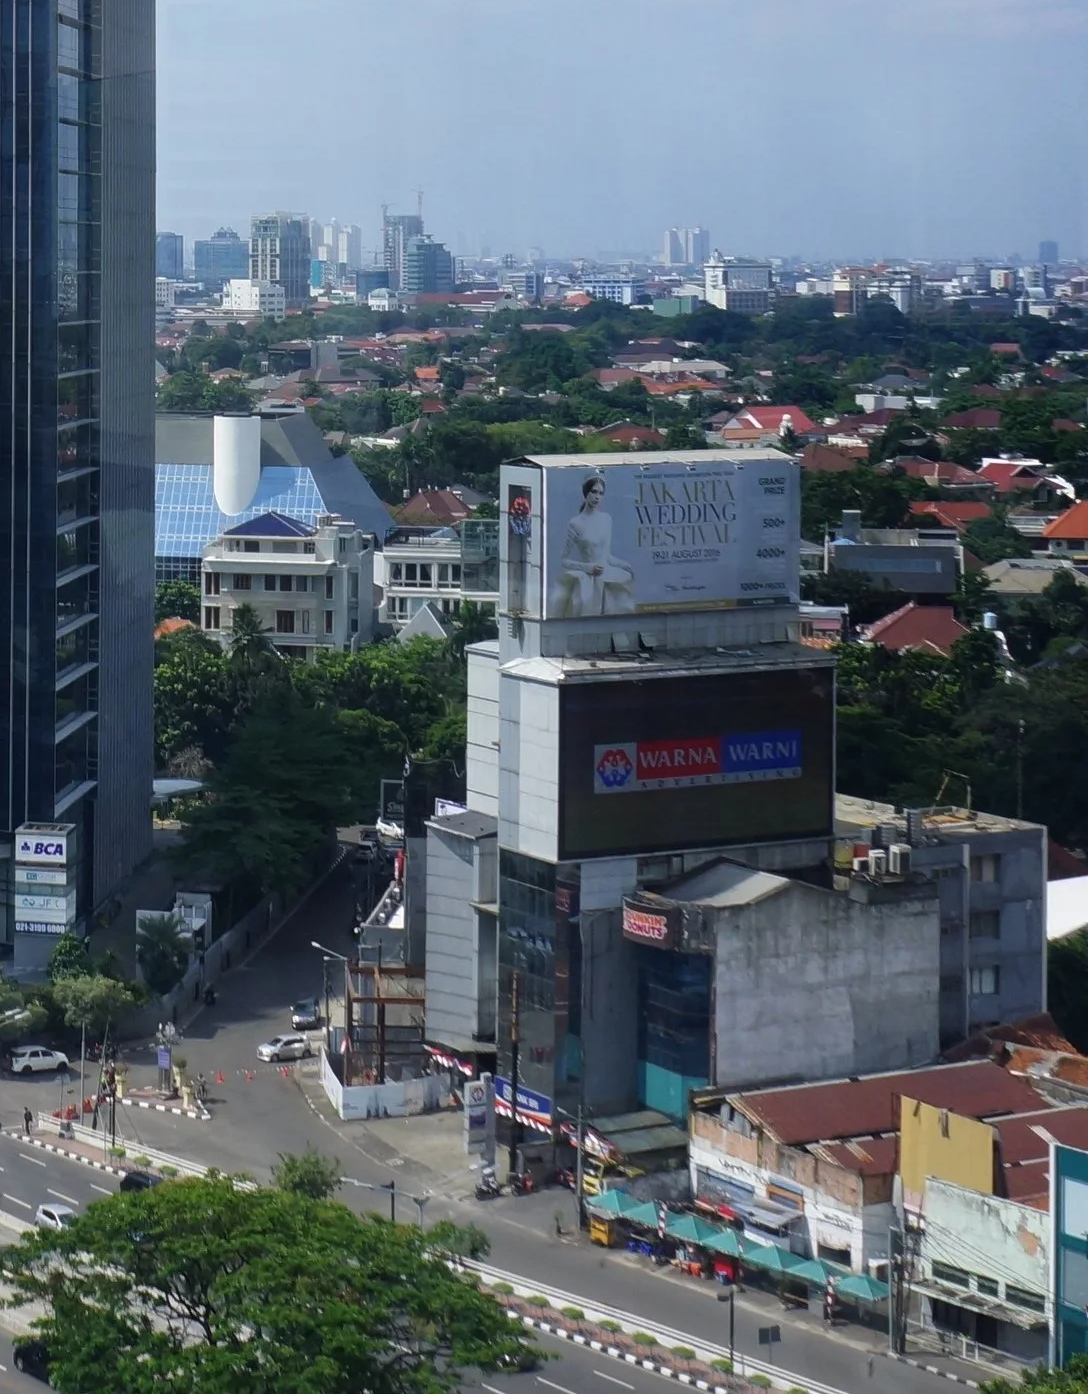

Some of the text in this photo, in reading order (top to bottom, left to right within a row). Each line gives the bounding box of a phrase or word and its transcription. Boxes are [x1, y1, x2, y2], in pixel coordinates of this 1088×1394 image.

[758, 477, 786, 486] GRAND
[634, 479, 736, 505] JAKARTA
[763, 486, 785, 495] PRIZE
[635, 502, 737, 525] WEDDING
[762, 518, 786, 528] 500+
[636, 523, 738, 548] FESTIVAL
[671, 549, 702, 559] AUGUST
[755, 548, 786, 558] 4000+
[639, 739, 798, 769] WARNA WARNI
[33, 842, 64, 856] BCA
